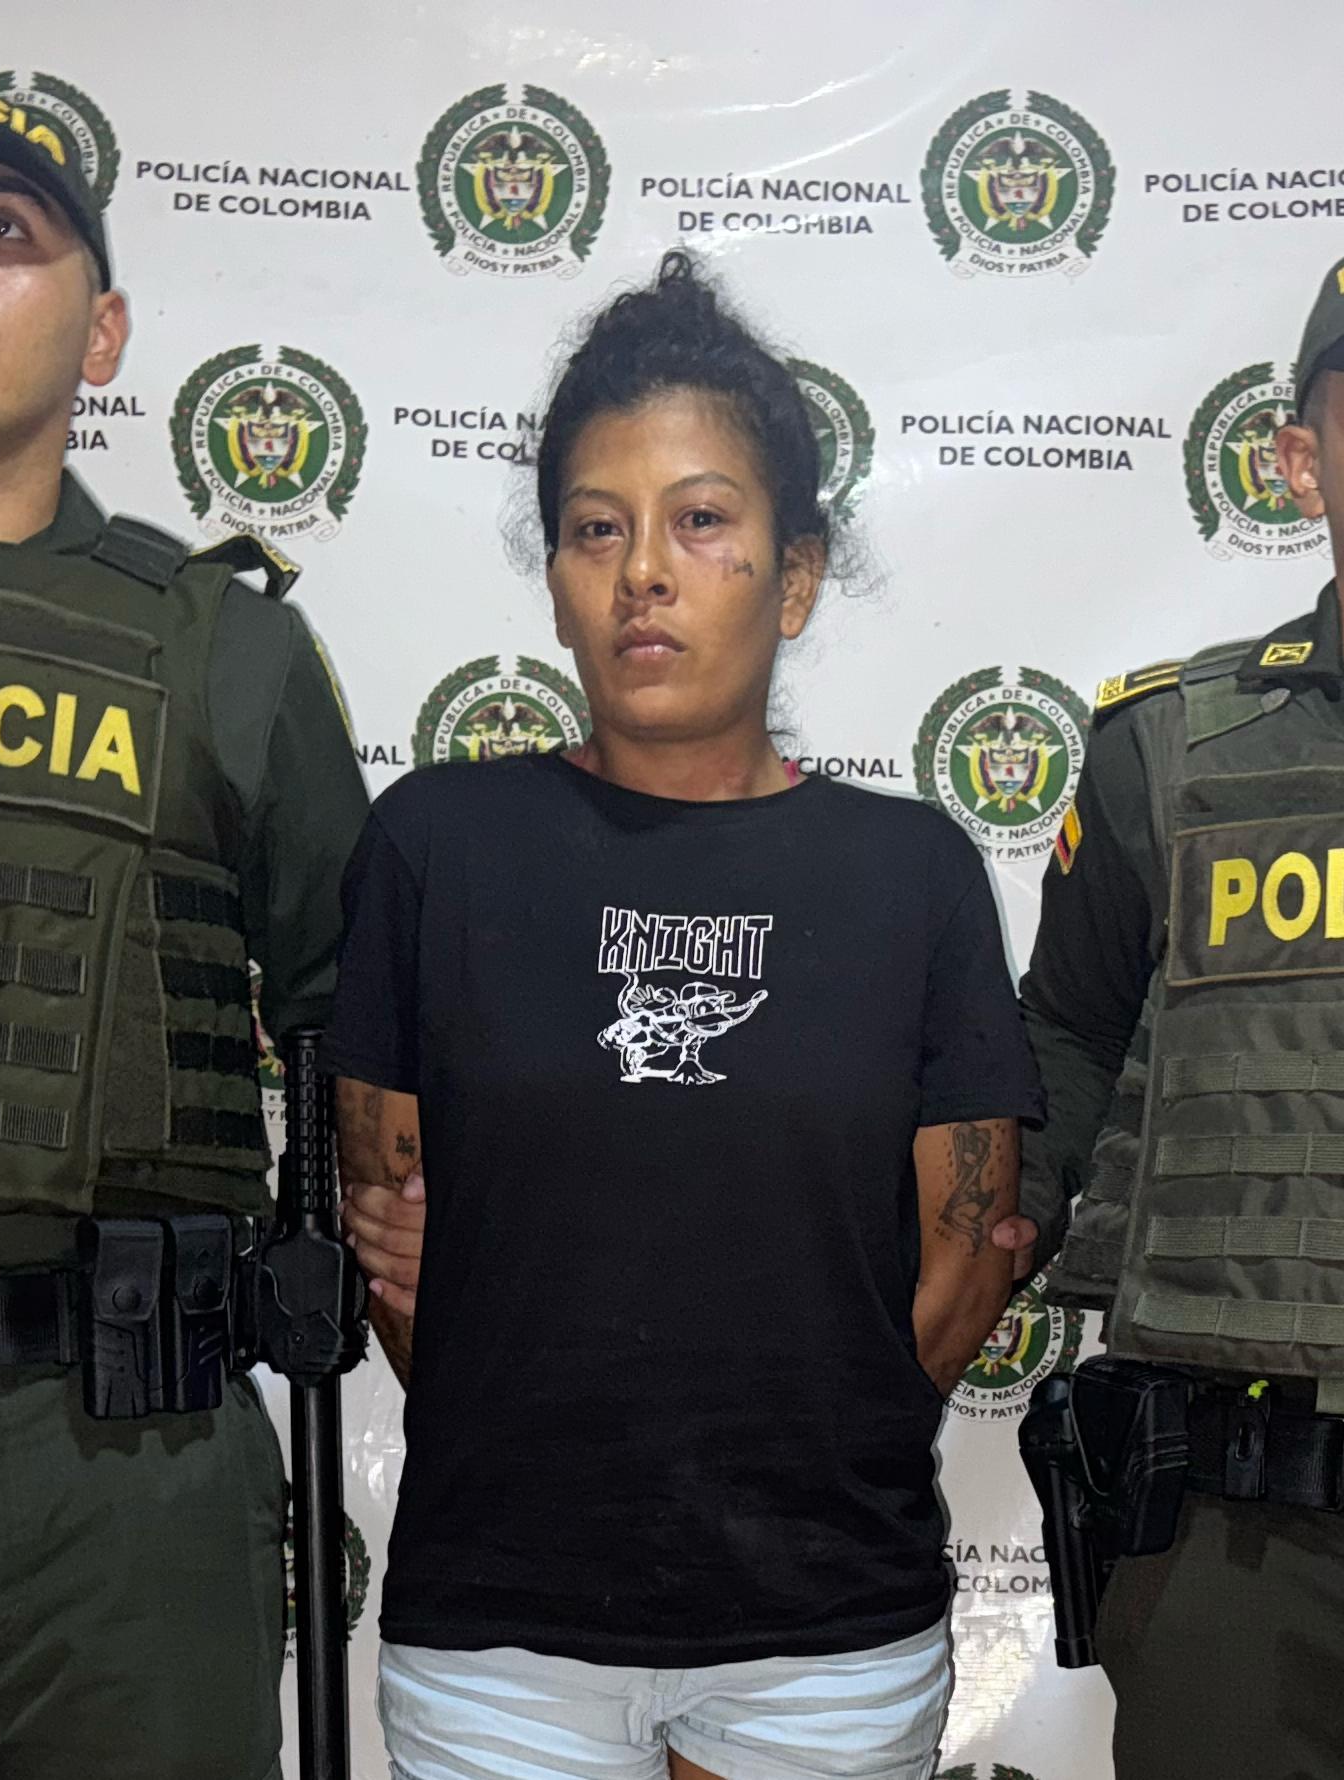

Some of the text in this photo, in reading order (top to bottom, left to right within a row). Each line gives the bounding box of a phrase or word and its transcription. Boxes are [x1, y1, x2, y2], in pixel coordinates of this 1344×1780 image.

[136, 161, 410, 192] POLICÍA NACIONAL
[640, 173, 911, 203] POLICÍA NACIONAL
[1145, 168, 1257, 193] POLICÍA
[173, 193, 372, 221] DE COLOMBIA
[1183, 204, 1219, 222] DE
[678, 211, 873, 235] DE COLOMBIA
[72, 396, 146, 416] ONAL
[394, 406, 508, 430] POLICÍA
[901, 410, 1172, 439] POLICÍA NACIONAL
[432, 439, 468, 458] DE
[939, 446, 1134, 471] DE COLOMBIA
[1277, 516, 1323, 538] NACIO
[537, 688, 580, 749] COLOM
[798, 757, 903, 778] CIONAL
[598, 906, 773, 979] KNIGHT
[991, 1402, 1028, 1419] PATRI
[955, 1574, 1051, 1594] COLOM
